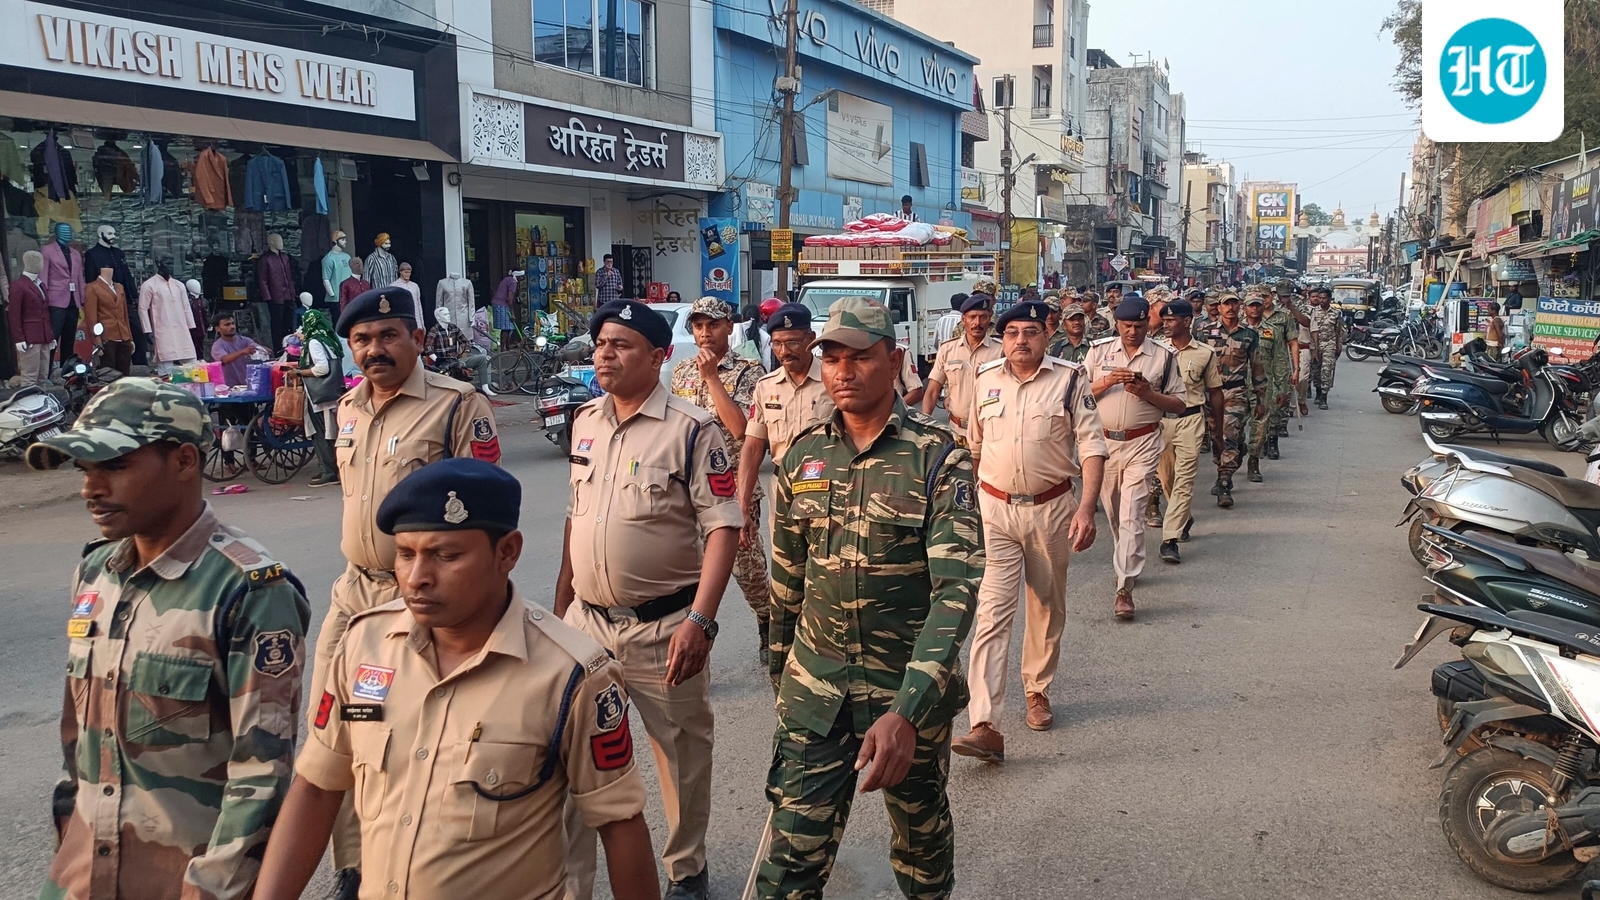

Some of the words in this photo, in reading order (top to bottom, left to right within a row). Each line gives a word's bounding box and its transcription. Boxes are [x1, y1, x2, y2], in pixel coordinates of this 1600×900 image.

[767, 0, 828, 46] vvo
[37, 14, 183, 78] VIKASH
[196, 42, 286, 94] MENS
[296, 59, 377, 107] WEAR
[548, 116, 617, 163] अरिहंत
[622, 127, 669, 171] ट्रेडर्स
[1572, 172, 1591, 198] BABLU
[1258, 193, 1286, 207] GK
[638, 201, 701, 227] अरिहंत
[1259, 209, 1285, 217] TMT
[1259, 225, 1285, 239] GK
[653, 229, 696, 257] ट्रेडर्स
[1540, 299, 1570, 312] फोटो
[1538, 313, 1560, 323] COLOUR
[1561, 315, 1582, 325] PHOTO
[1535, 324, 1563, 336] ONLINE
[1563, 326, 1599, 339] SERVICES
[1527, 592, 1550, 601] STREET
[1530, 588, 1588, 608] BURGMAN
